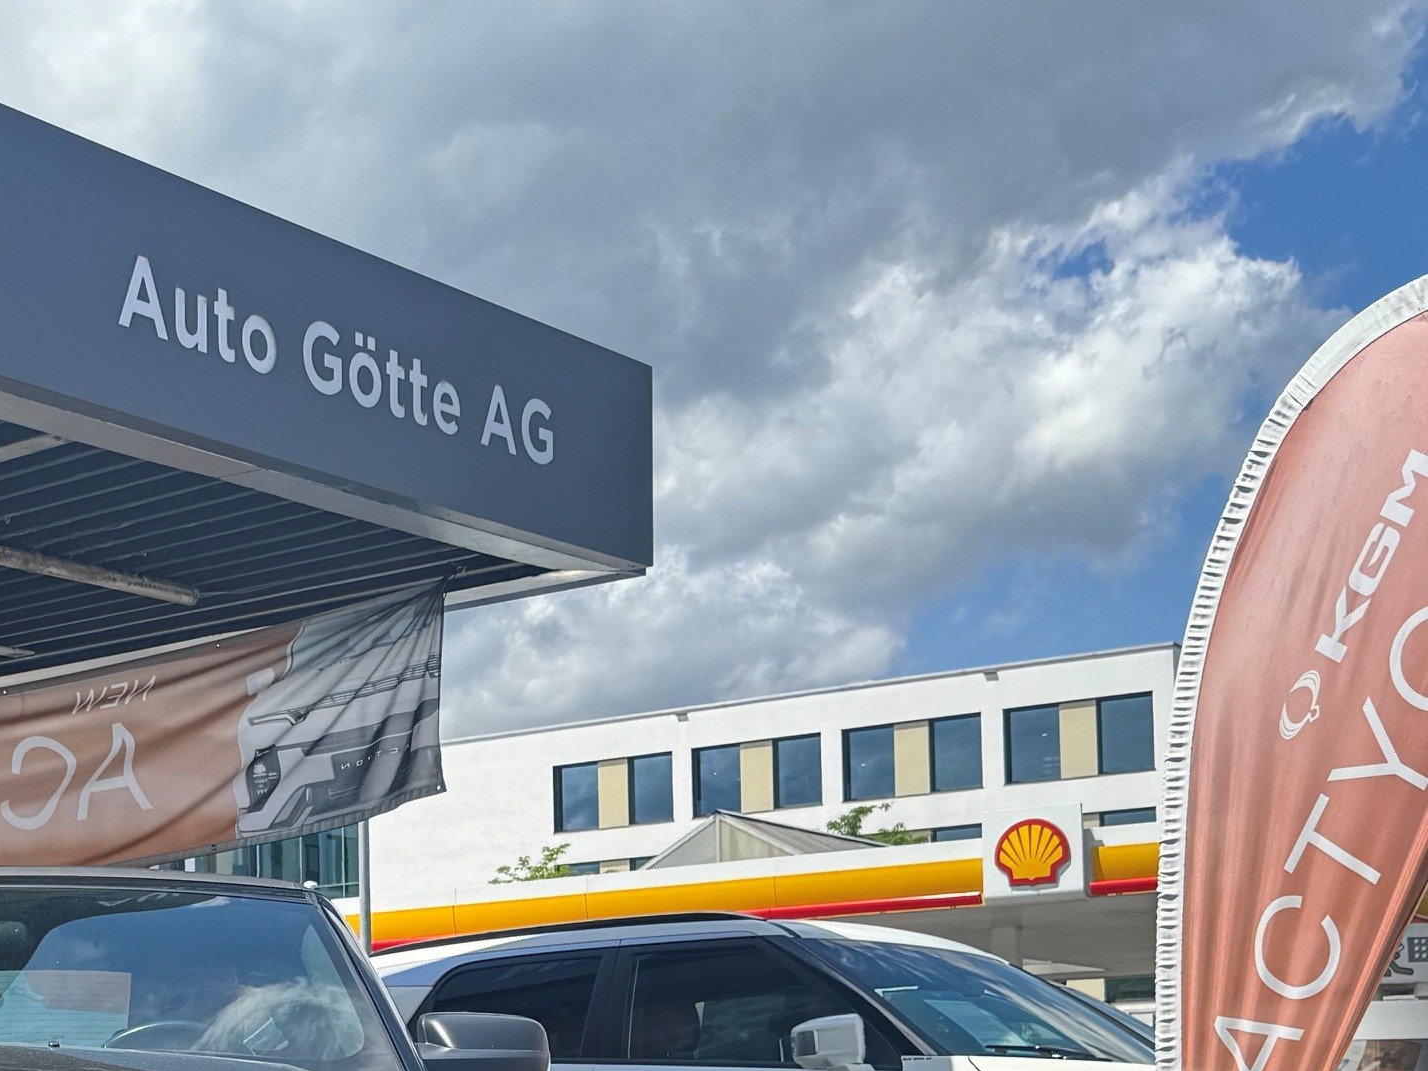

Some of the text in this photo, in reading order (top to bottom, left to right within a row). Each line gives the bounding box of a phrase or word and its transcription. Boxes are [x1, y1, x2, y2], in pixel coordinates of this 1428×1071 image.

[118, 254, 555, 465] Auto Götte AG
